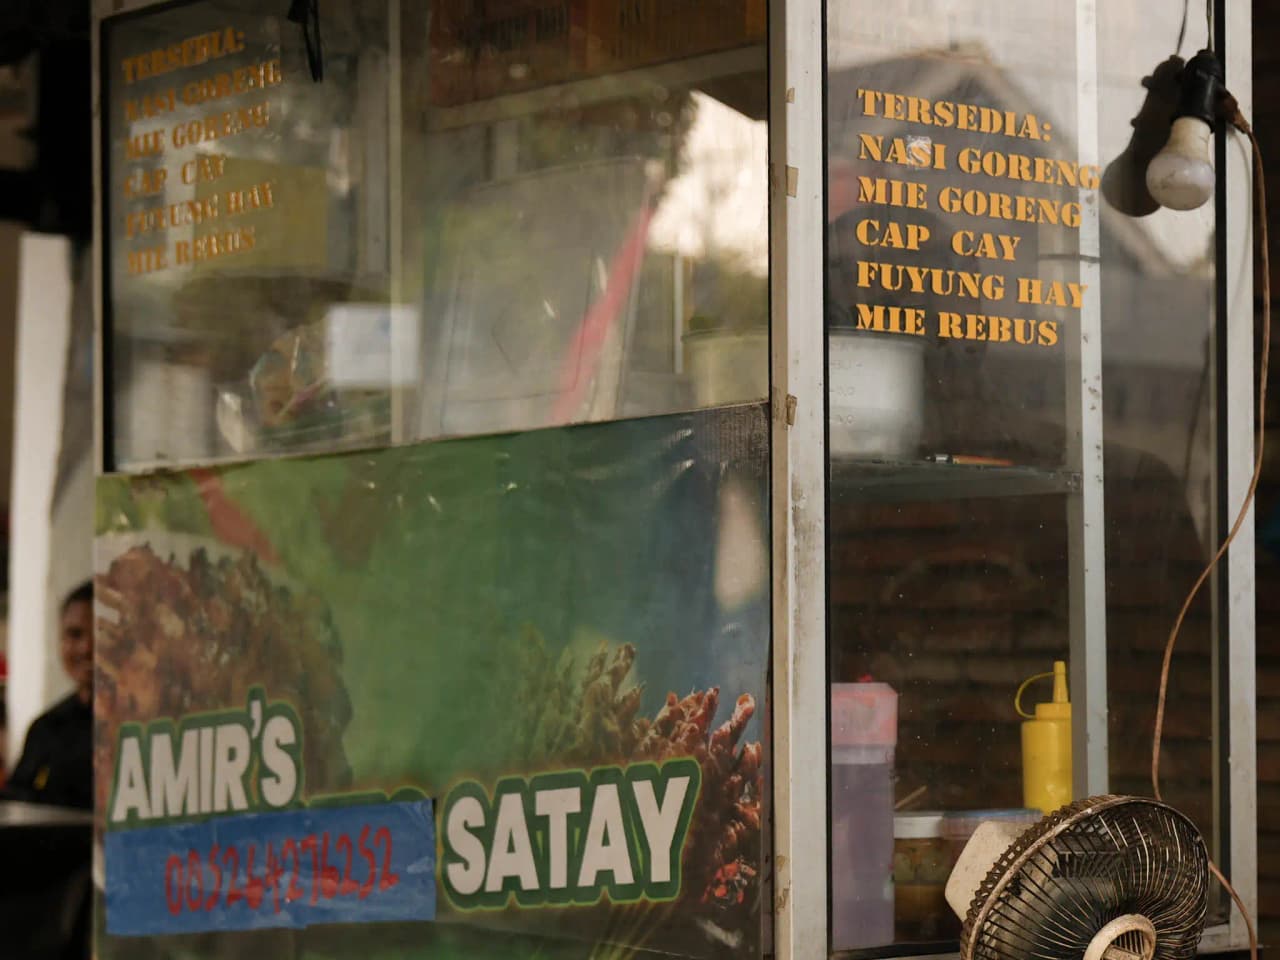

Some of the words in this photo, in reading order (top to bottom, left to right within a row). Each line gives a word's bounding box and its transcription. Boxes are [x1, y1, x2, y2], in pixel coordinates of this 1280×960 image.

[857, 89, 1052, 142] TERSEDIA:
[859, 133, 946, 170] NASI
[958, 147, 1100, 190] GORENG
[857, 176, 928, 209] MIE
[938, 186, 1083, 228] GORENG
[856, 219, 930, 250] CAP
[951, 230, 1021, 261] CAY
[856, 260, 1005, 300] FUYUNG
[1017, 277, 1088, 308] HAY
[856, 303, 926, 336] MIE
[938, 311, 1058, 346] REBUS
[111, 700, 297, 823] AMIR'S
[447, 776, 690, 895] SATAY
